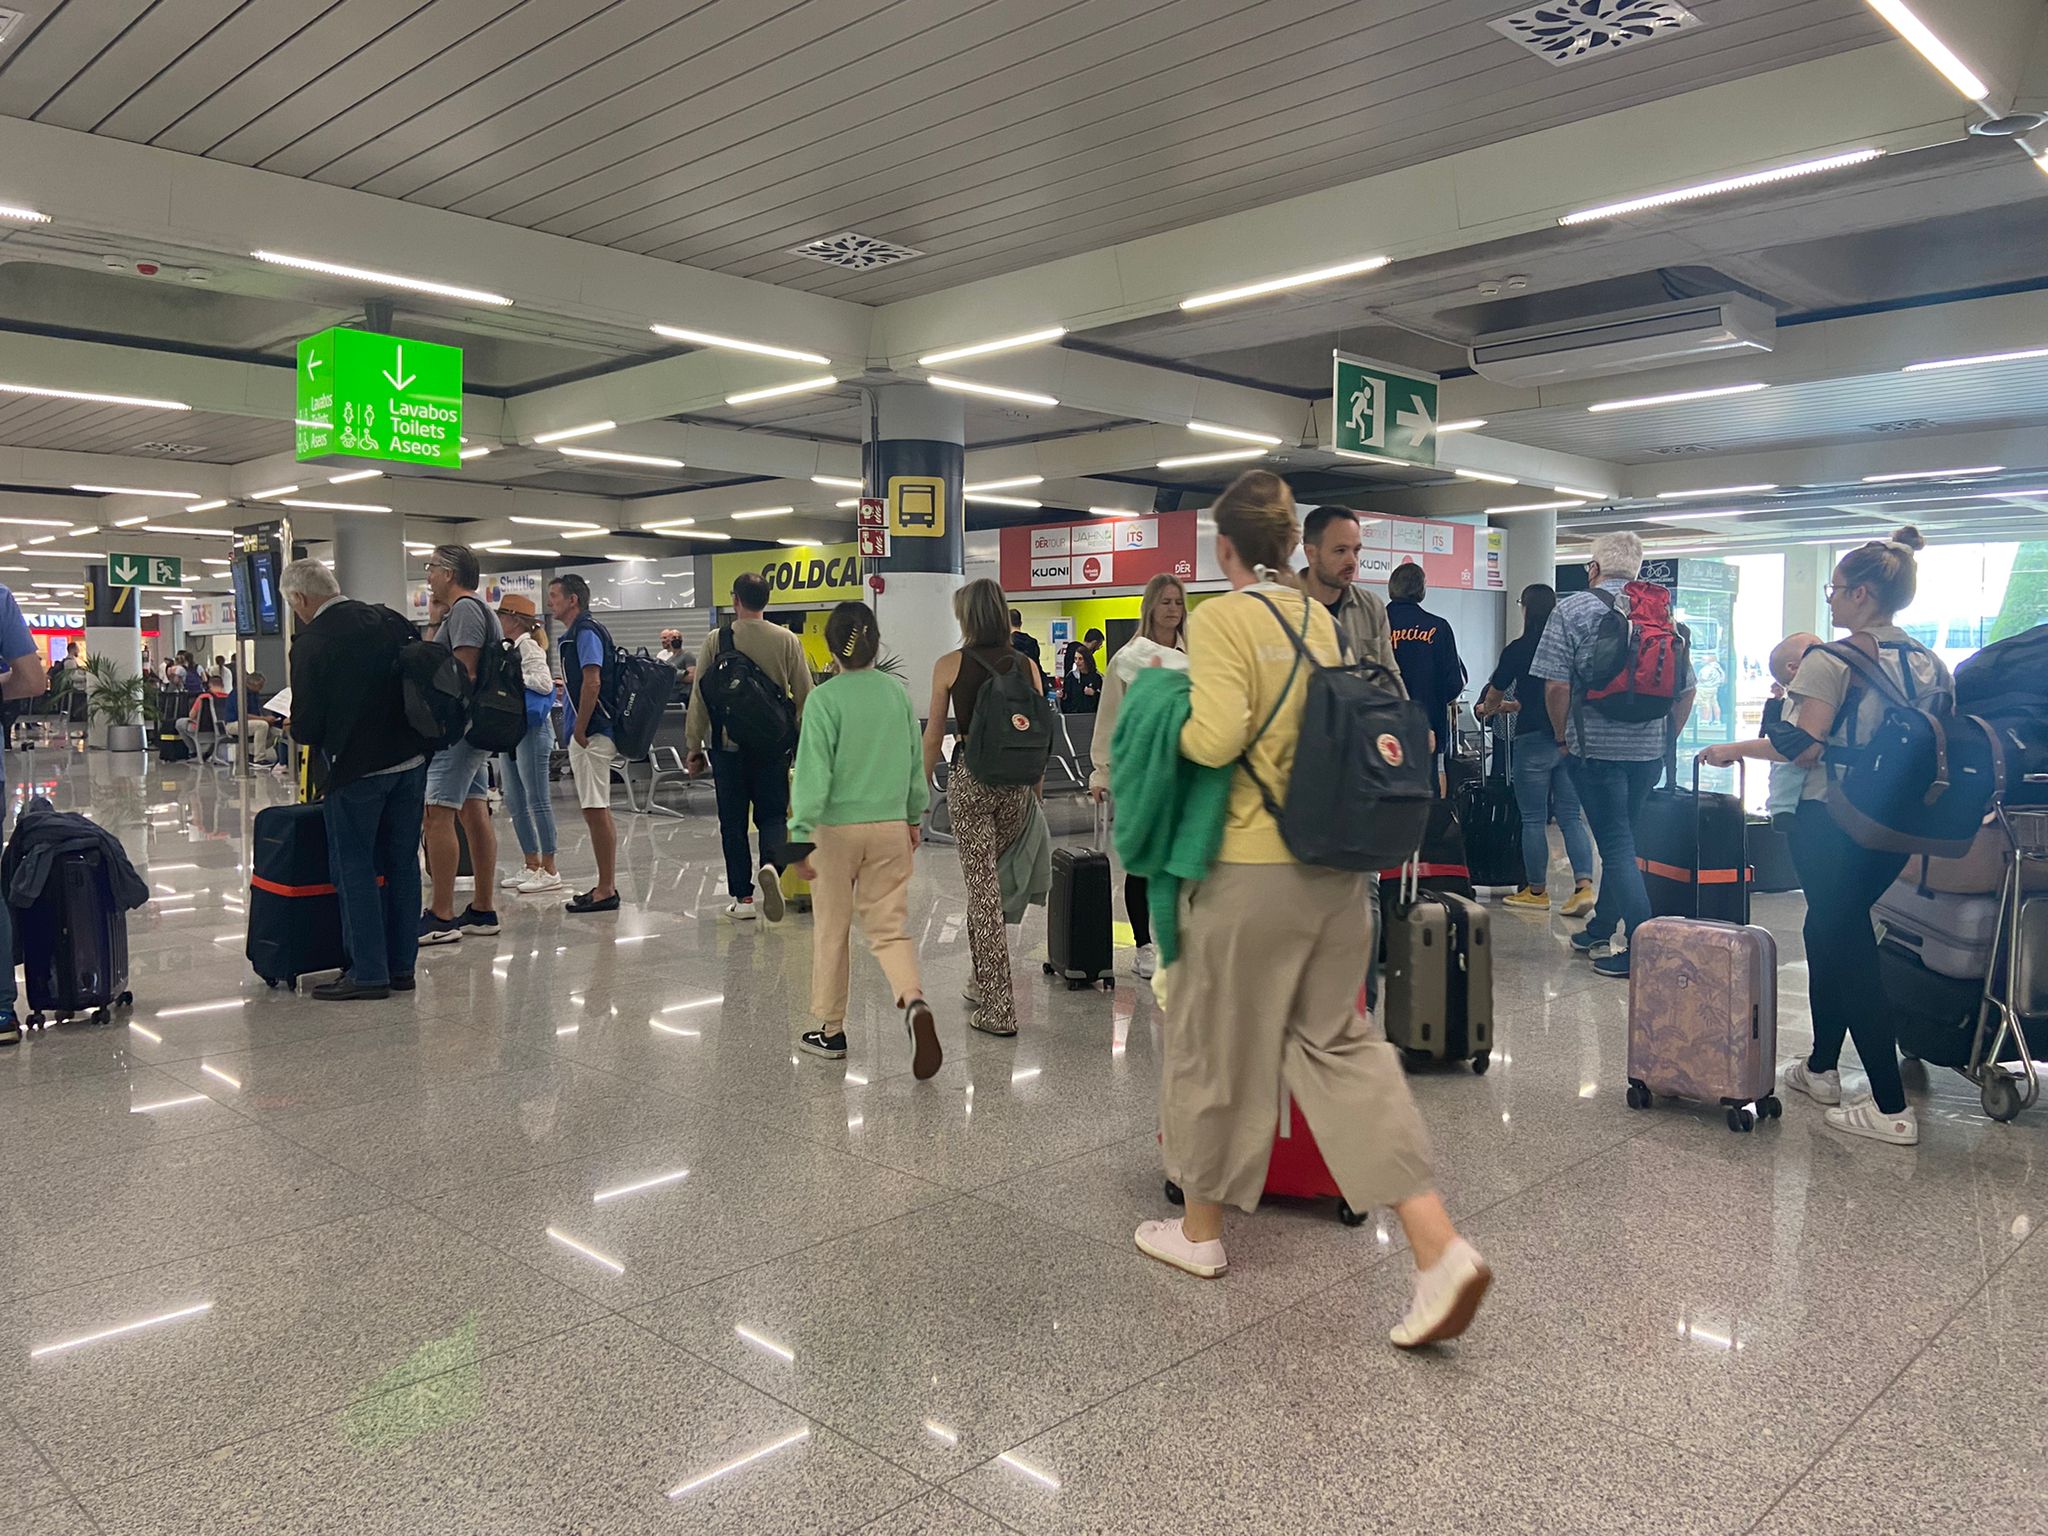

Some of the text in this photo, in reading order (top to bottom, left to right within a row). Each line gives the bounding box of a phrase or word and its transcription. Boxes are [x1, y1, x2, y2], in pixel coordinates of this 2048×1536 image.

[390, 398, 458, 423] Lavabos
[390, 417, 445, 439] Toilets
[390, 436, 441, 457] Aseos
[1126, 531, 1143, 542] ITS
[1432, 535, 1444, 546] ITS
[1032, 567, 1069, 577] KUONI
[1174, 561, 1191, 574] DER
[1360, 559, 1390, 571] KUONI
[761, 557, 863, 591] GOLDCA
[500, 575, 535, 592] Shuttle
[1389, 625, 1437, 649] pecial
